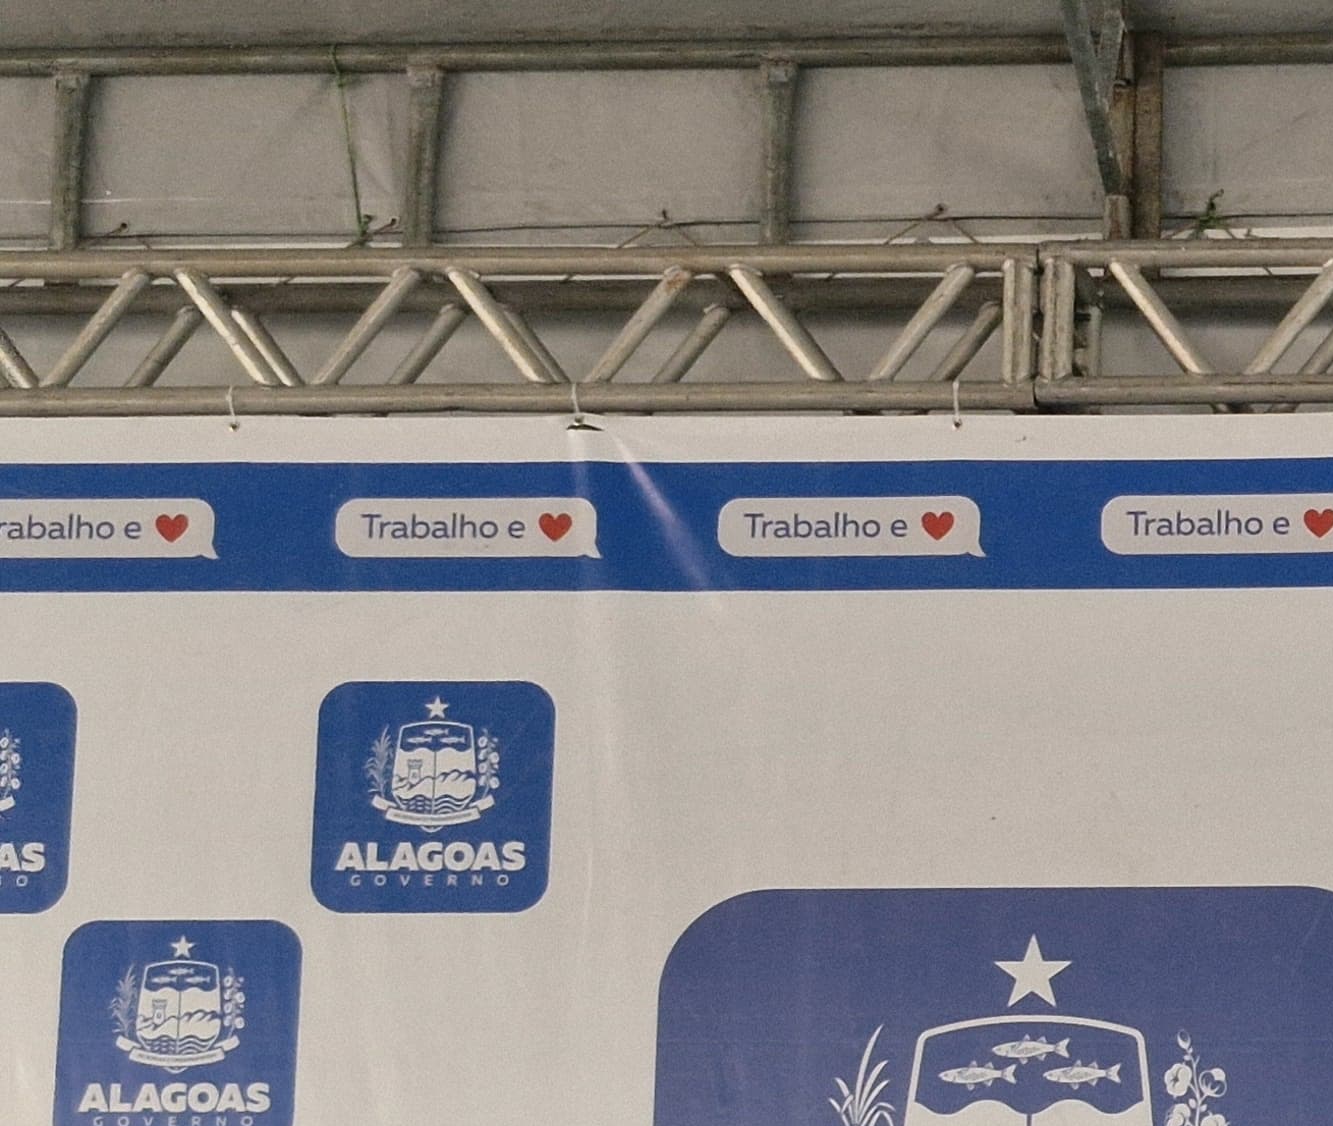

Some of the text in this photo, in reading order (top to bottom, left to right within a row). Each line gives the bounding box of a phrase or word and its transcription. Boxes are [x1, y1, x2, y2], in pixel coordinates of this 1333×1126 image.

[0, 513, 141, 540] abalho e
[361, 513, 525, 539] Trabalho e
[744, 512, 908, 538] Trabalho e
[1126, 509, 1290, 536] Trabalho e
[335, 841, 525, 871] ALAGOAS
[349, 874, 510, 886] GOVERNO
[77, 1083, 270, 1113] ALAGOAS
